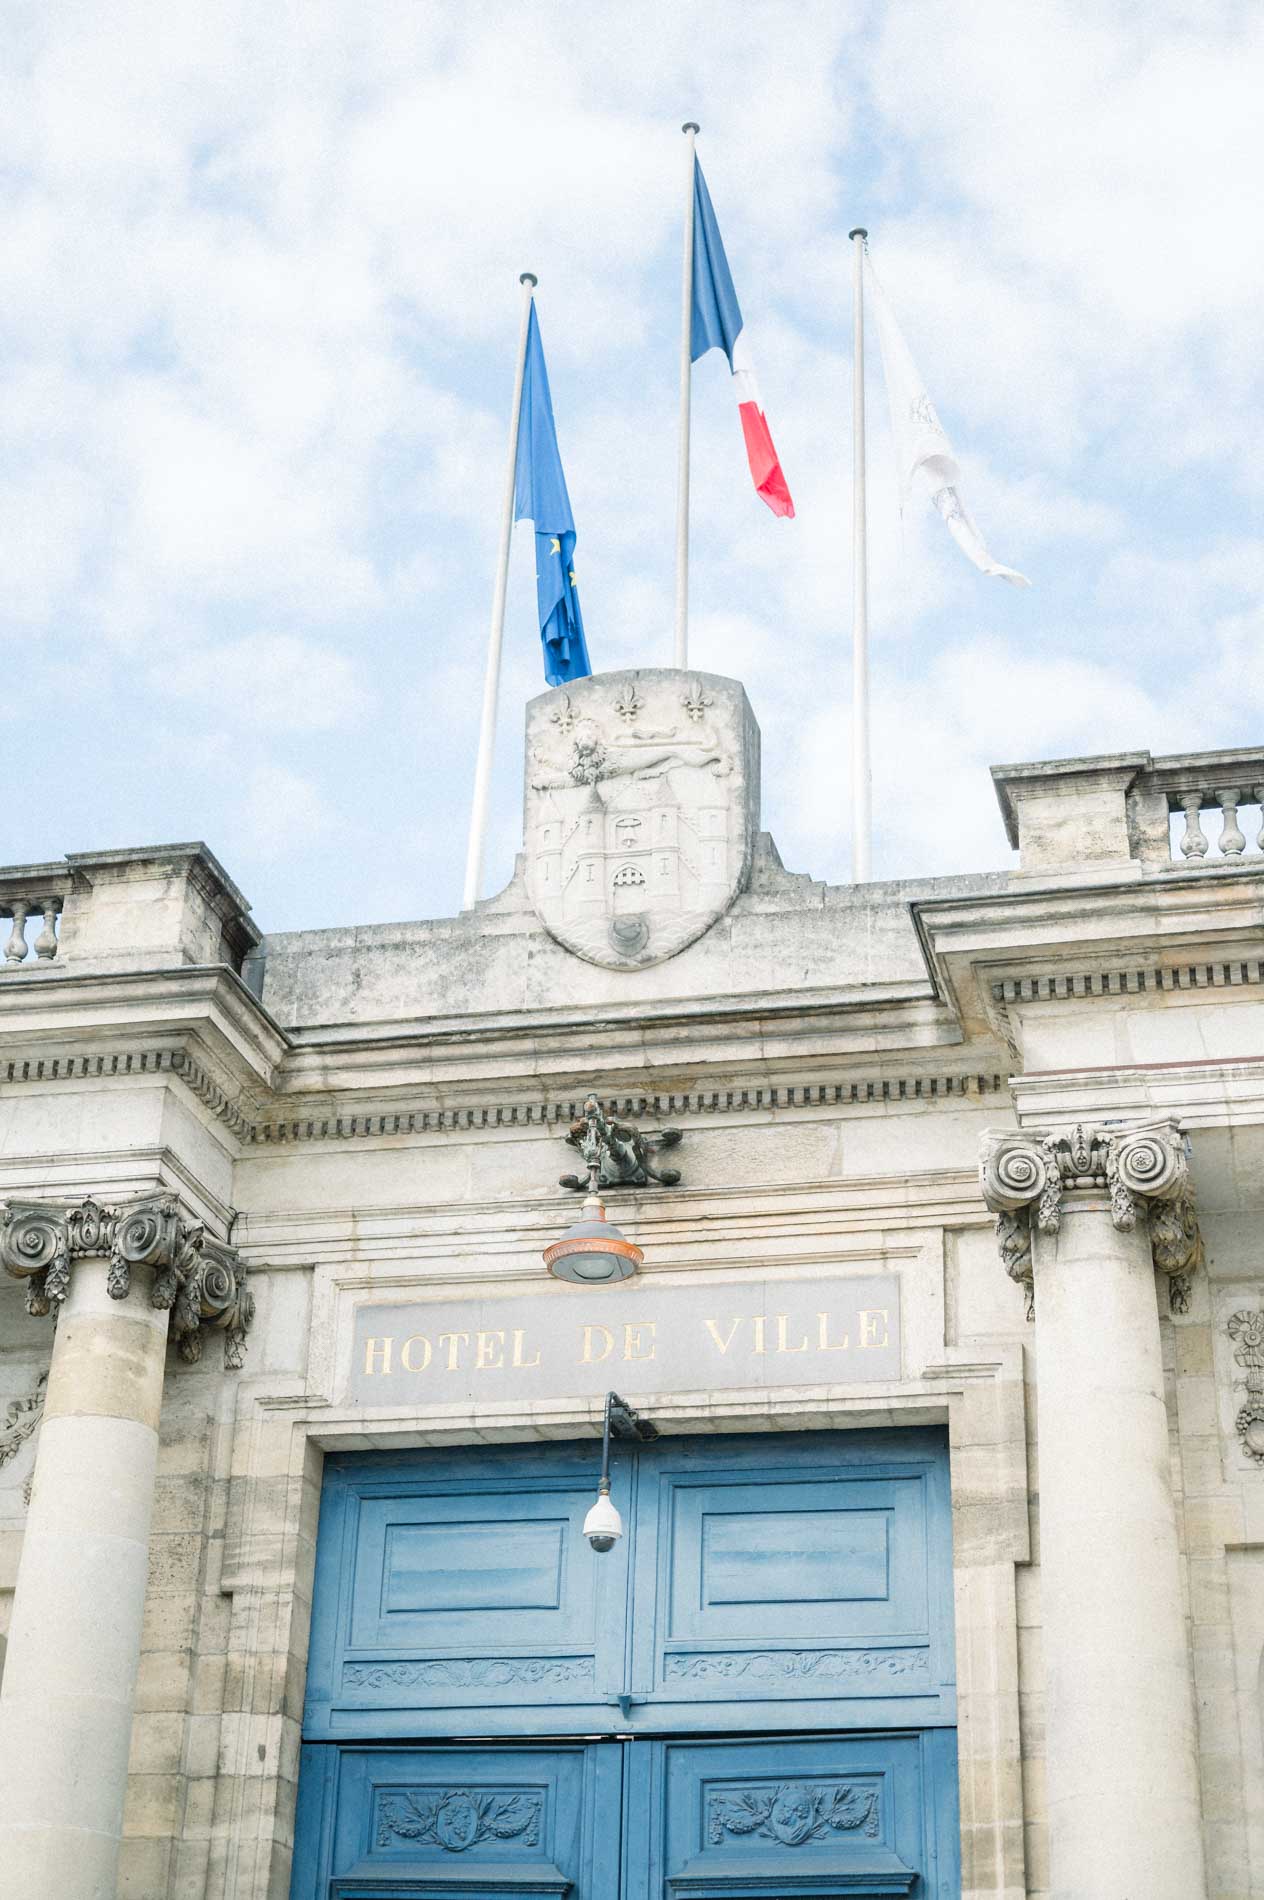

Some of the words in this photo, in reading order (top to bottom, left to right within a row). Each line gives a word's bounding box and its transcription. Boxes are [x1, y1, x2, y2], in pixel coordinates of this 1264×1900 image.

[363, 1329, 541, 1375] HOTEL
[576, 1321, 656, 1364] DE
[703, 1309, 888, 1355] VILLE
